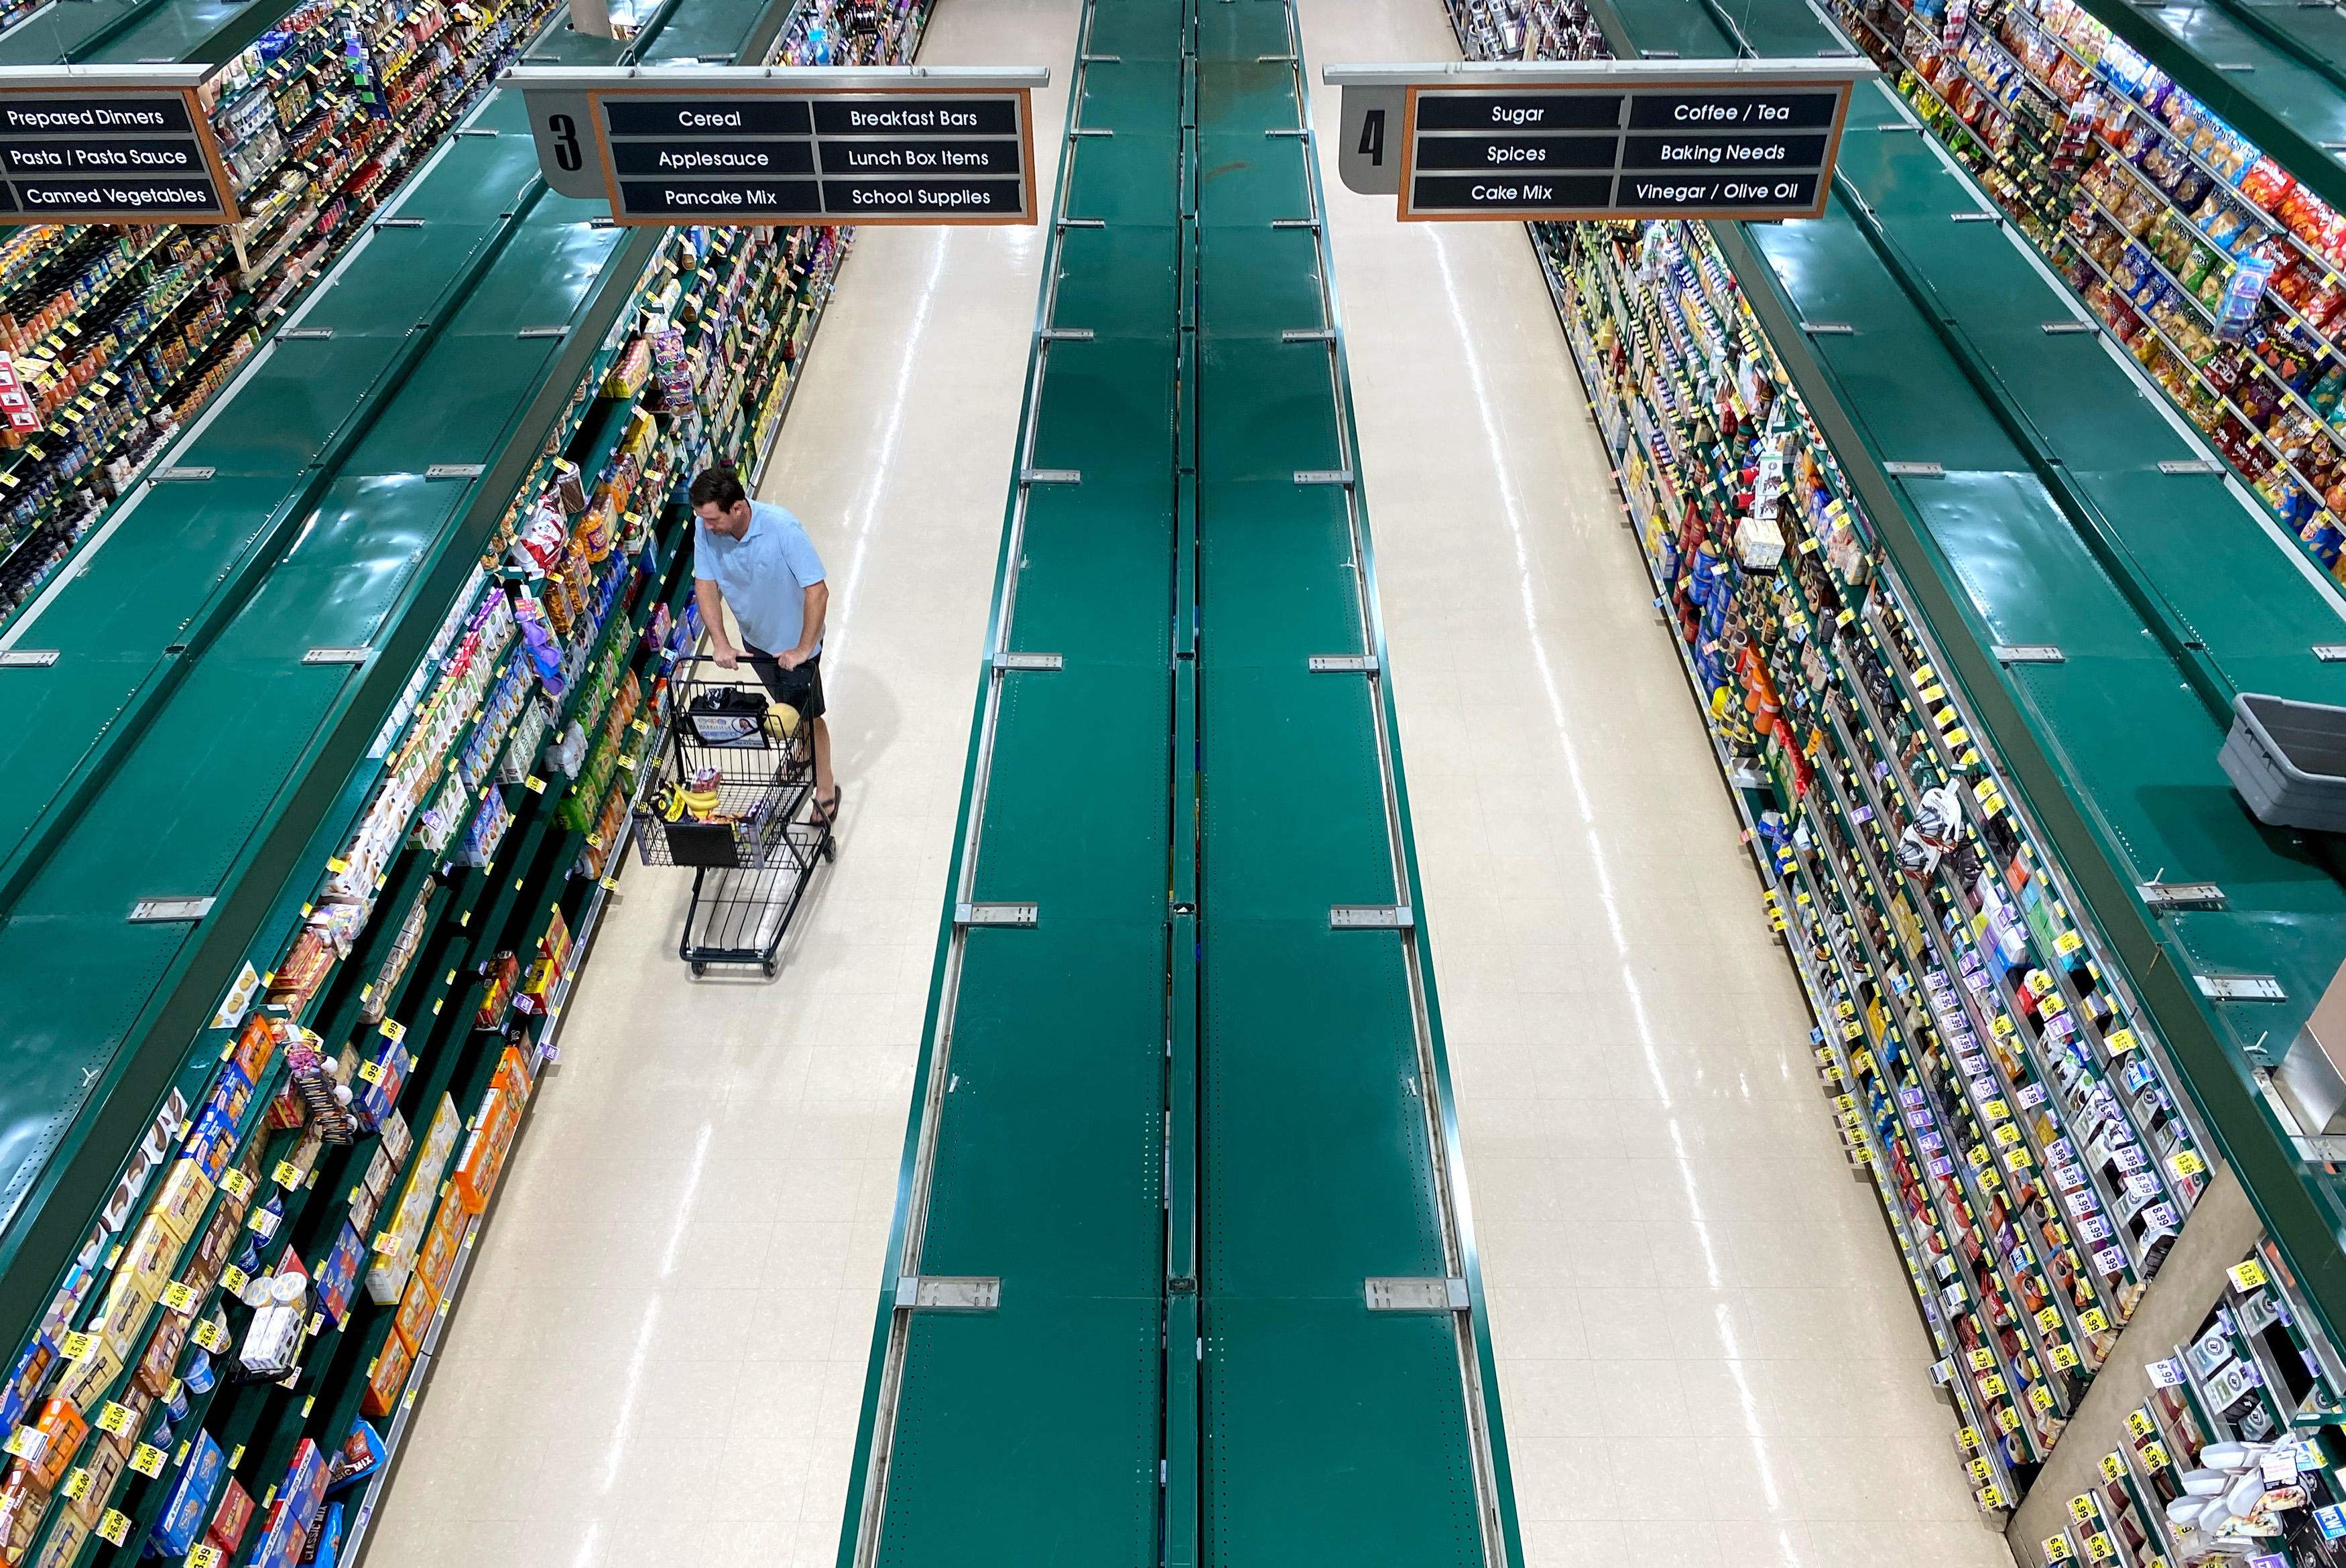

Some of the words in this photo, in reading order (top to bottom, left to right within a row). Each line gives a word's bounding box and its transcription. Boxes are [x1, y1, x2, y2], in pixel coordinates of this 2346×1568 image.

[7, 110, 94, 127] Prepared
[96, 110, 164, 124] Dinners
[679, 111, 741, 126] Cereal
[851, 111, 934, 125] Breakfast
[940, 111, 977, 125] Bars
[1492, 107, 1544, 124] Sugar
[1674, 105, 1737, 119] Coffee
[1759, 105, 1789, 119] Tea
[548, 114, 582, 171] 3
[1358, 110, 1385, 166] 4
[11, 151, 62, 164] Pasta
[76, 150, 127, 164] Pasta
[130, 149, 186, 164] Sauce
[660, 151, 768, 168] Applesauce
[849, 151, 901, 165] Lunch
[906, 151, 936, 165] Box
[942, 151, 988, 165] Items
[1487, 147, 1546, 164] Spices
[1662, 145, 1721, 163] Baking
[1727, 145, 1784, 159] Needs
[27, 189, 101, 203] Canned
[103, 188, 206, 205] Vegetables
[666, 190, 741, 204] Pancake
[747, 190, 777, 204] Mix
[853, 190, 912, 204] School
[918, 190, 990, 206] Supplies
[1472, 186, 1517, 200] Cake
[1524, 186, 1552, 199] Mix
[1637, 184, 1706, 201] Vinegar
[1725, 184, 1768, 198] Olive
[1775, 184, 1798, 198] Oil
[1930, 973, 1942, 986] 7.99
[2035, 976, 2044, 991] 4.99
[2045, 998, 2056, 1013] 4.99
[388, 1023, 397, 1037] .99
[1949, 1013, 1961, 1029] 7.99
[1995, 1018, 2005, 1035] 4.99
[1958, 1035, 1971, 1049] 7.99
[368, 1065, 378, 1081] .99
[1969, 1058, 1981, 1071] 7.99
[2026, 1087, 2038, 1103] 7.99
[2101, 1106, 2111, 1117] 8.9
[1852, 1129, 1861, 1142] 5.99
[196, 1140, 207, 1165] Lance
[1859, 1149, 1868, 1161] 5.99
[1973, 1148, 1983, 1164] 9.99
[2012, 1151, 2024, 1167] 11.99
[2050, 1142, 2065, 1160] 8.99
[2122, 1149, 2138, 1166] 8.99
[2176, 1155, 2194, 1174] 13.99
[229, 1173, 244, 1194] 2/6.00
[280, 1165, 294, 1185] 2/6.00
[1983, 1171, 1993, 1187] 9.99
[2063, 1168, 2077, 1185] 8.99
[2136, 1177, 2152, 1193] 8.99
[2075, 1193, 2090, 1211] 8.99
[2153, 1207, 2169, 1225] 8.99
[2087, 1220, 2103, 1238] 8.99
[2103, 1250, 2117, 1269] 8.99
[229, 1270, 243, 1291] 2/6.00
[2240, 1265, 2258, 1285] 13.99
[170, 1286, 188, 1307] 2/6.00
[2040, 1311, 2054, 1329] 11.49
[2083, 1312, 2099, 1331] 6.99
[201, 1324, 217, 1346] 2/6.00
[1974, 1352, 1987, 1367] 4.79
[2056, 1348, 2069, 1366] 6.99
[2158, 1364, 2176, 1383] 8.99
[1987, 1378, 1999, 1394] 4.79
[2034, 1390, 2046, 1410] 11.49
[107, 1407, 125, 1431] 2/6.00
[2001, 1411, 2013, 1429] 6.99
[2130, 1414, 2144, 1437] 6.99
[1963, 1430, 1973, 1447] 4.79
[193, 1441, 203, 1461] PACKS
[2145, 1446, 2160, 1468] 6.99
[140, 1449, 157, 1472] 2/6.00
[298, 1453, 310, 1481] PACKS
[354, 1455, 373, 1472] MIX
[2103, 1457, 2117, 1478] 6.99
[1973, 1461, 1985, 1479] 4.79
[73, 1474, 89, 1500] 2/6.00
[13, 1486, 25, 1508] Nekot
[174, 1490, 184, 1512] PACKS
[1985, 1489, 1996, 1506] 4.79
[2075, 1498, 2088, 1518] 6.99
[107, 1514, 123, 1540] 2/6.00
[2319, 1507, 2343, 1532] NEW
[271, 1516, 283, 1543] PACKS
[304, 1524, 322, 1561] CLASSIC
[2050, 1539, 2063, 1557] 6.99
[2091, 1537, 2105, 1557] 6.99
